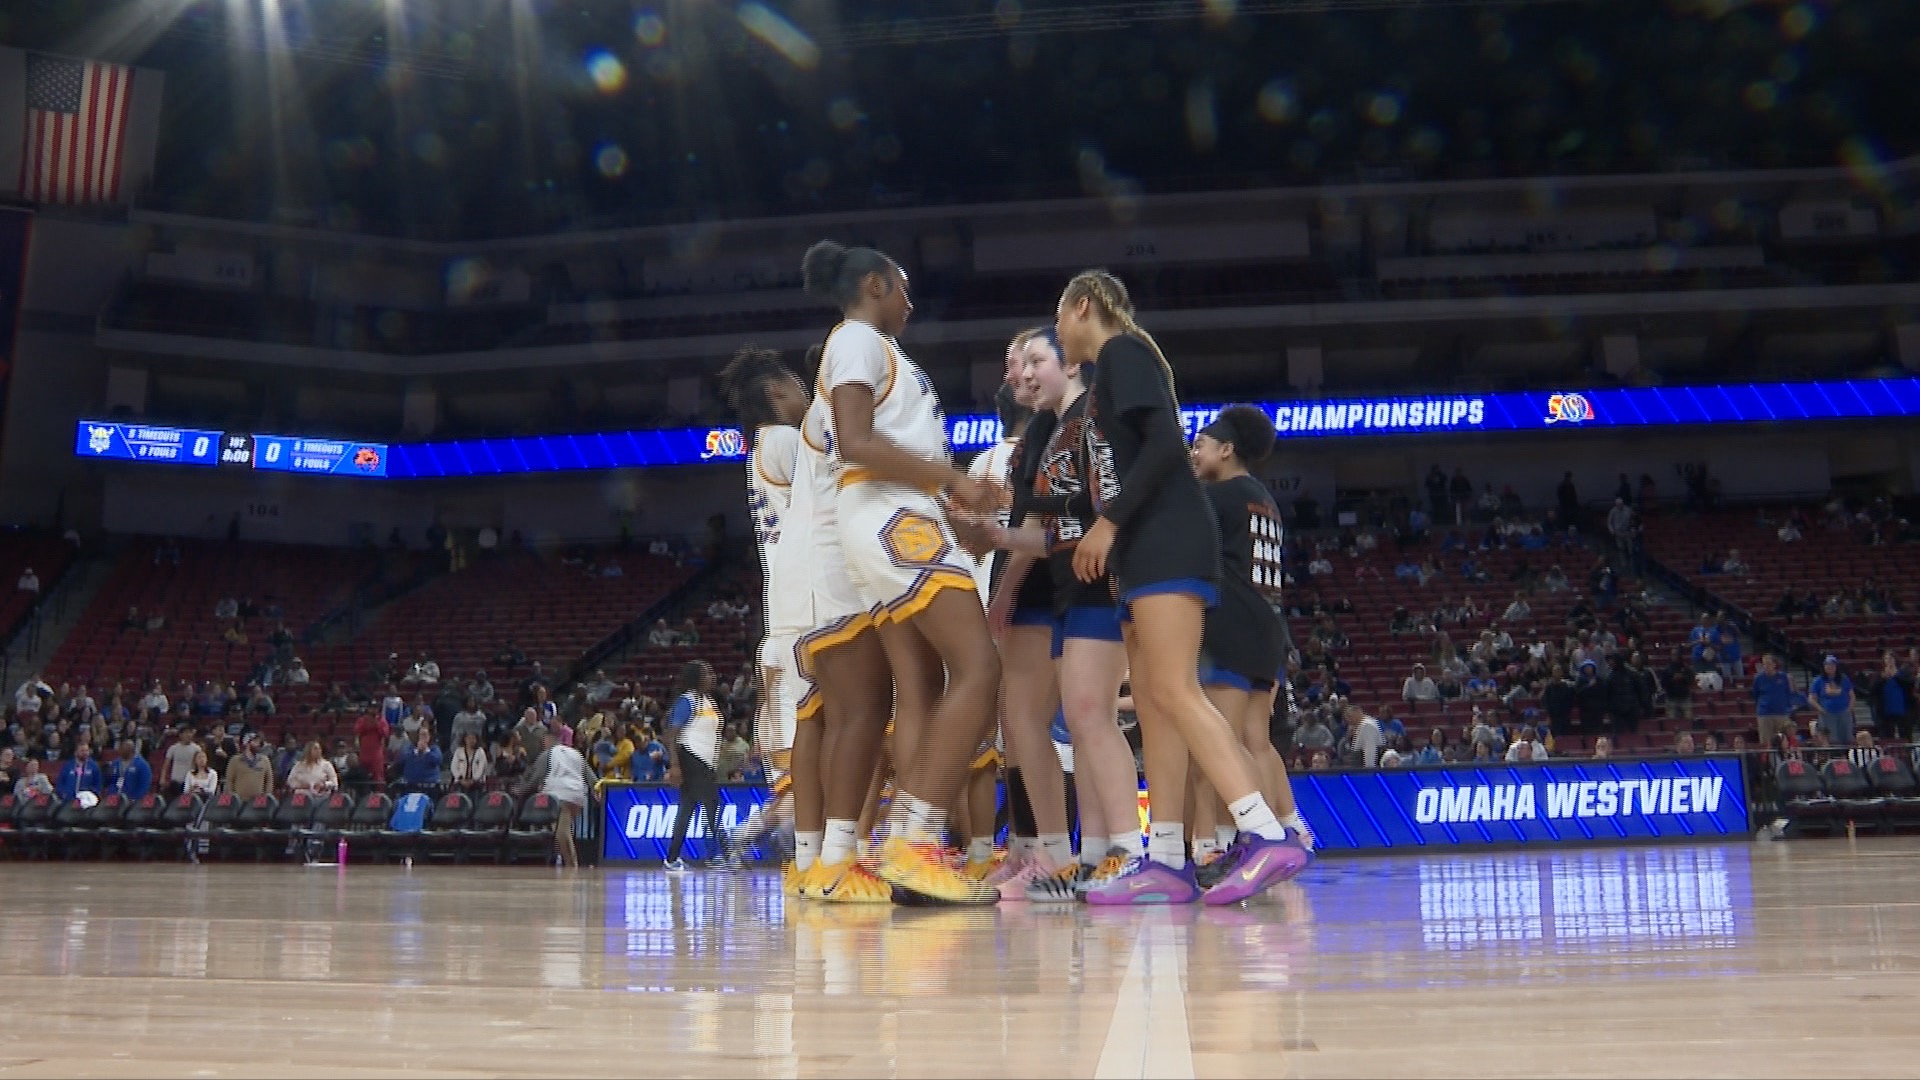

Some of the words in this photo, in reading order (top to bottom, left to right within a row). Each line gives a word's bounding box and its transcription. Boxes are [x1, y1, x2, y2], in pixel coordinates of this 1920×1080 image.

[1125, 243, 1156, 257] 204
[1275, 399, 1485, 432] CHAMPIONSHIPS
[148, 446, 177, 459] FOULS
[193, 436, 210, 458] 0
[265, 442, 282, 463] 0
[302, 458, 331, 470] FOULS
[247, 503, 279, 517] 104
[1415, 782, 1537, 825] OMAHA
[1542, 775, 1725, 819] WESTVIEW
